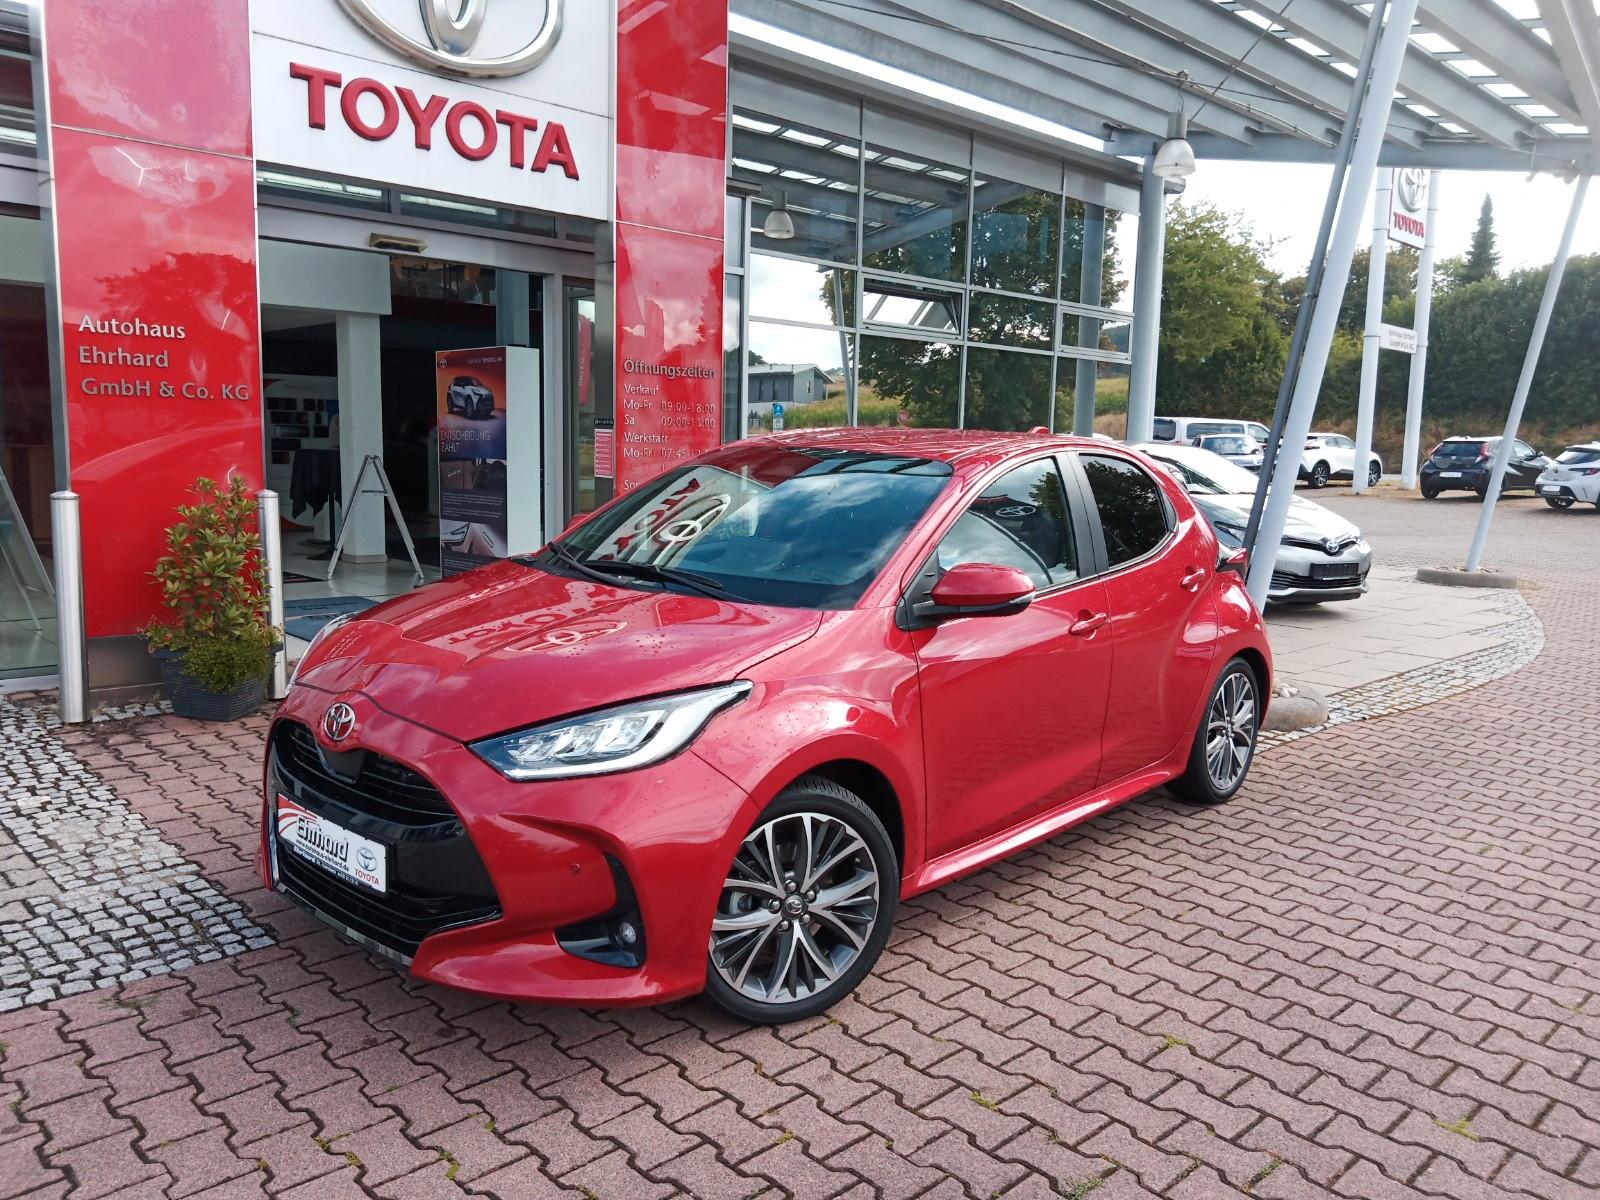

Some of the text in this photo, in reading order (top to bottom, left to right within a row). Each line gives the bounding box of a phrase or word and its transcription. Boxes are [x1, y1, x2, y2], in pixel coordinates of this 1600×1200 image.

[289, 61, 580, 181] TOYOTA
[1393, 211, 1425, 239] TOYOTA
[78, 314, 187, 340] Autohaus
[78, 345, 169, 369] Ehrhard
[623, 356, 716, 380] Öffnungszeiten
[81, 377, 250, 401] GmbH & Co. KG
[623, 383, 660, 396] Verkauf
[623, 399, 653, 411] Mo-Fr
[624, 414, 636, 426] Sa
[623, 431, 669, 444] Werkstatt
[623, 447, 653, 458] Mo-Fr
[354, 867, 381, 887] TOYOTA
